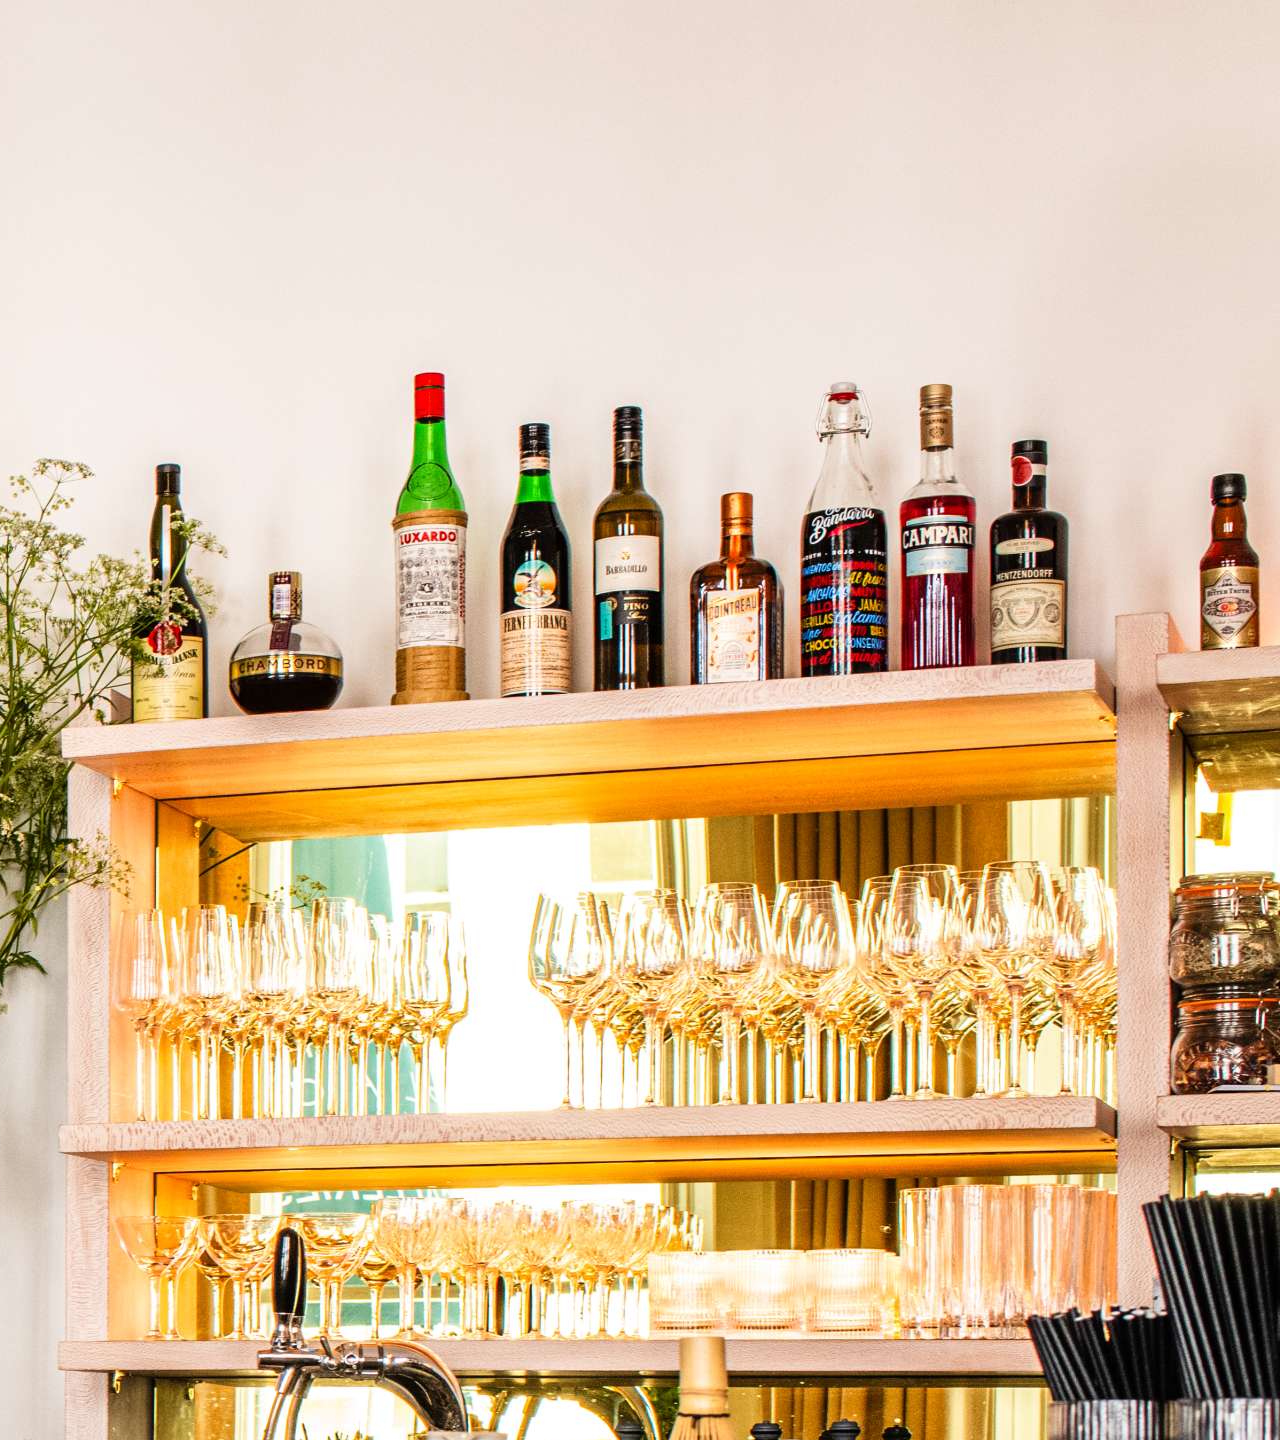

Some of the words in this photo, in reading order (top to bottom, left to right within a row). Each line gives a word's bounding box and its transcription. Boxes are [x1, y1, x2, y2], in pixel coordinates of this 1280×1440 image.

[809, 508, 874, 544] Bandarra
[399, 531, 457, 545] LUXARDO
[902, 525, 973, 550] CAMPARI
[605, 565, 648, 576] BARBADILLO
[996, 569, 1054, 582] MENTZENDORFF
[623, 602, 649, 611] FINO
[707, 594, 758, 620] COINTREAU
[238, 658, 330, 675] CHAMBORD
